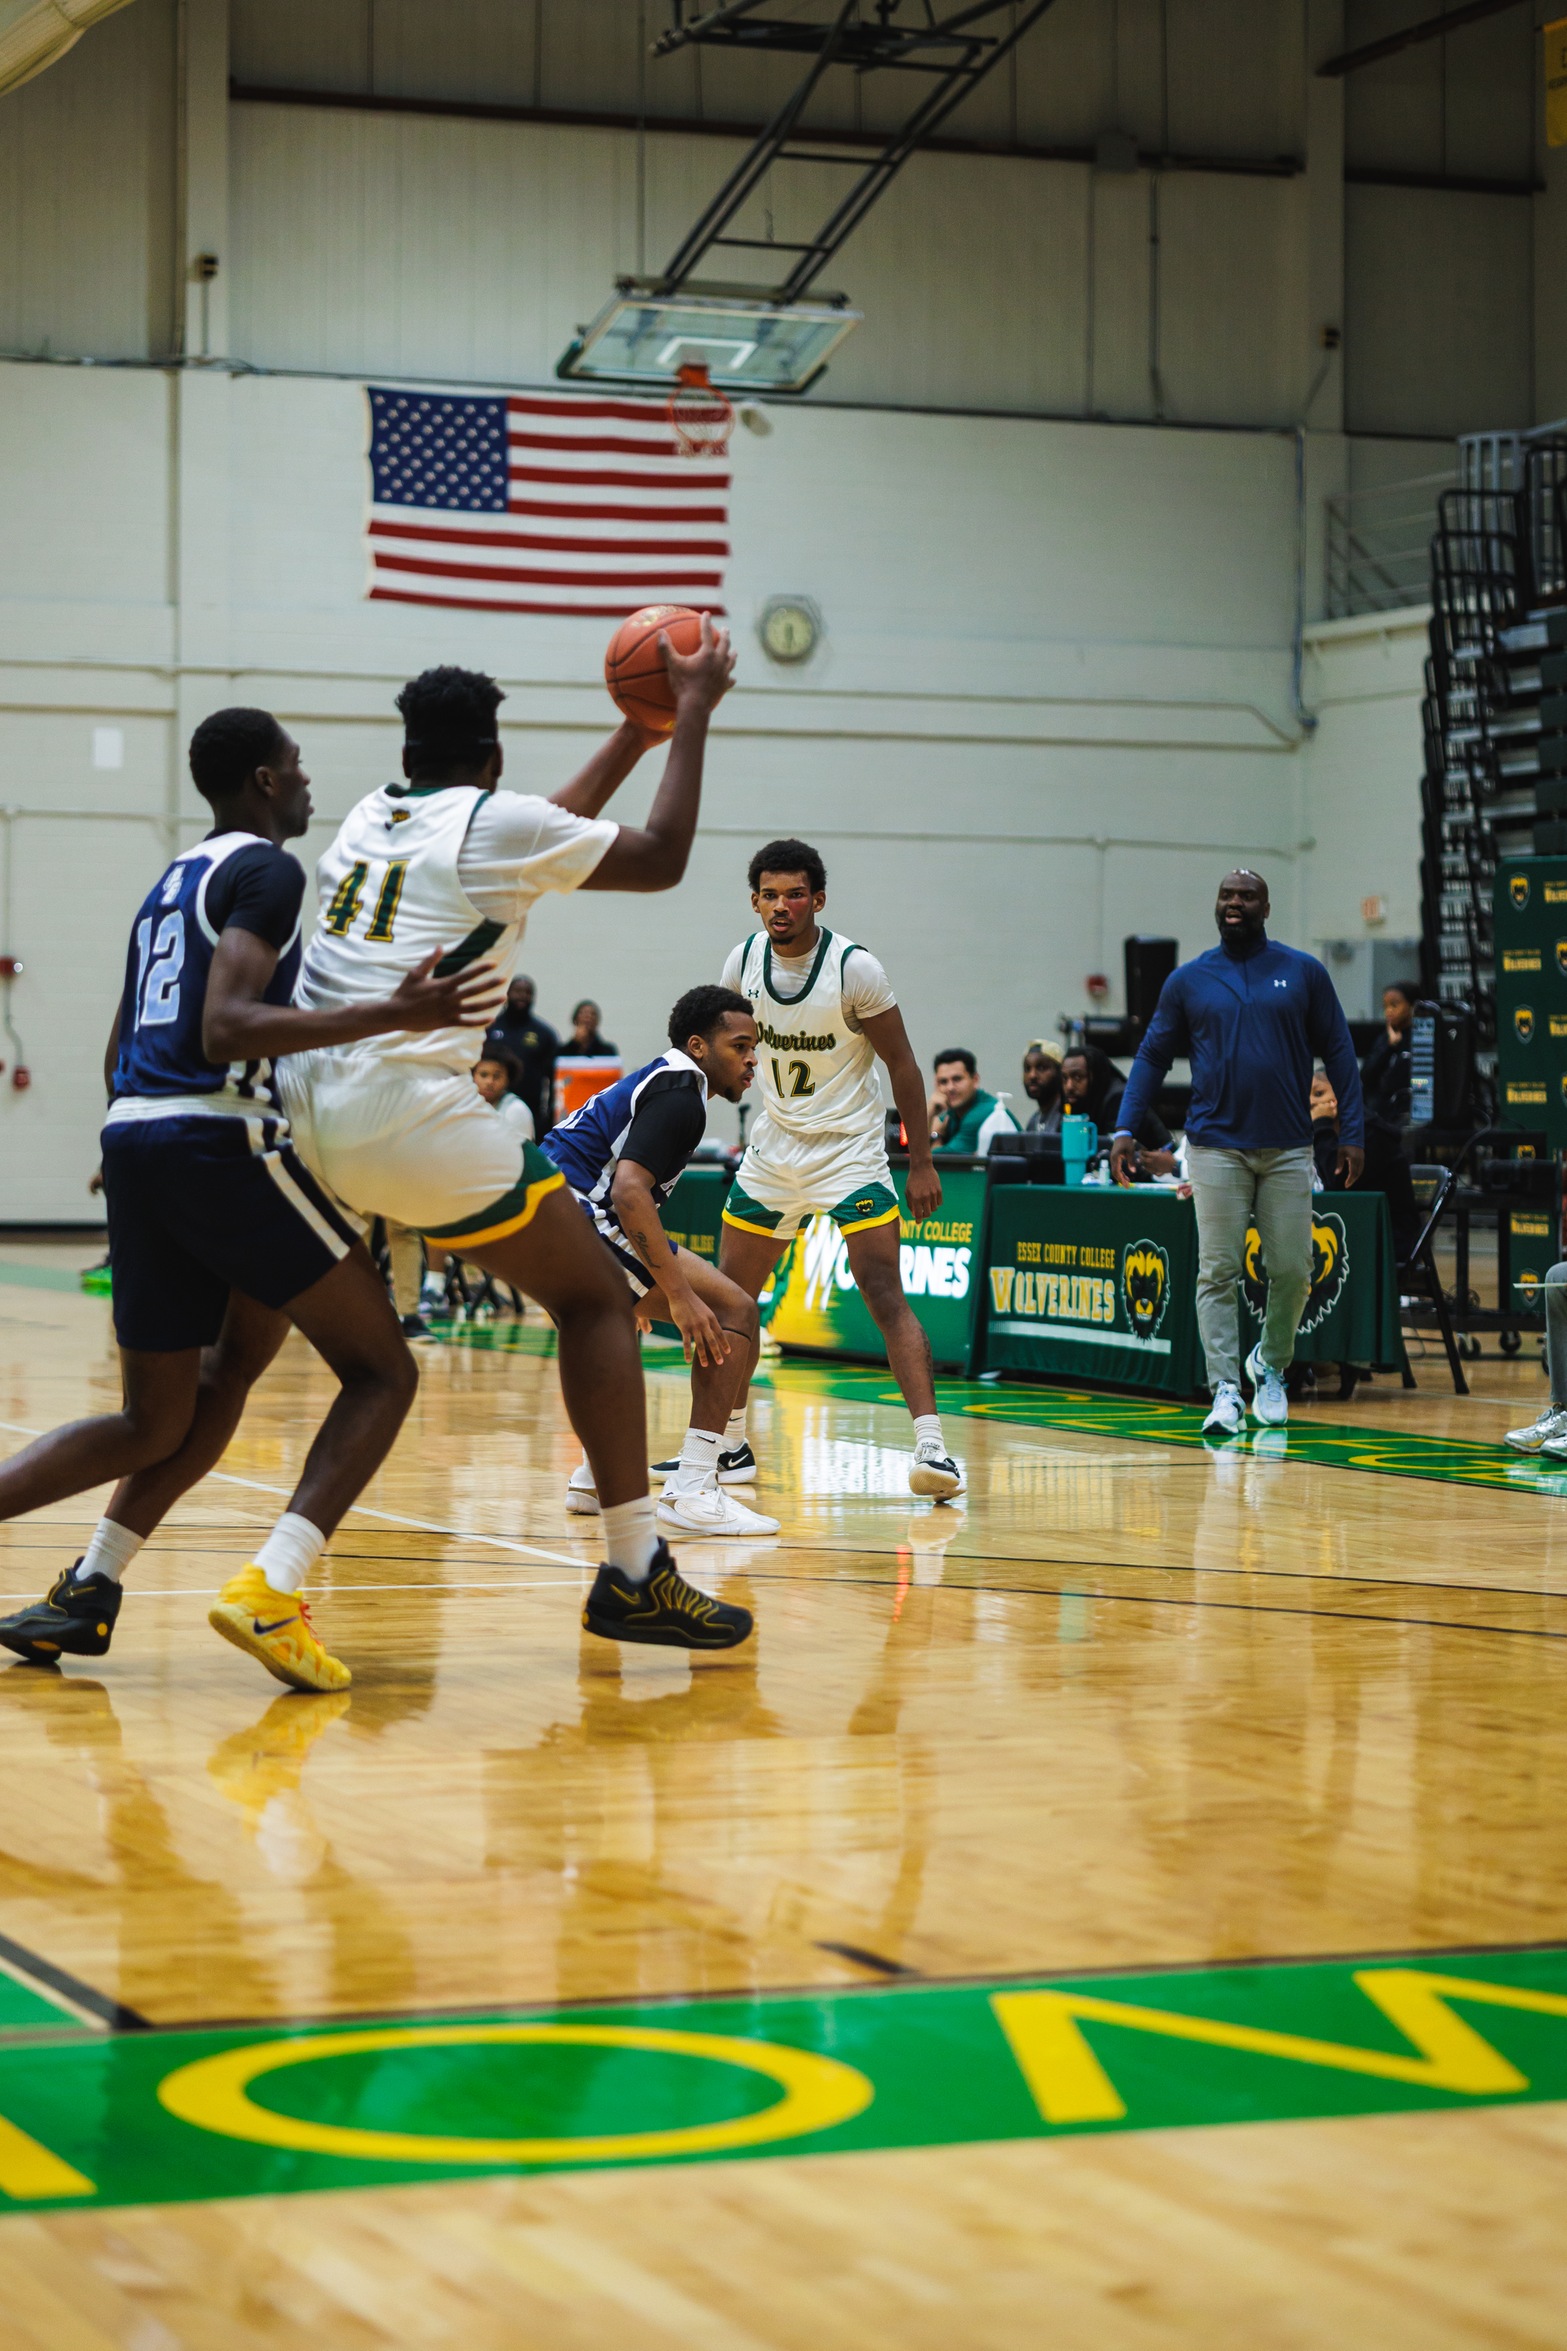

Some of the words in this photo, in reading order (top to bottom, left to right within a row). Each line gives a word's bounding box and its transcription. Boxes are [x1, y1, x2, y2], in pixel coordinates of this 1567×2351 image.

[325, 859, 410, 942] 41
[134, 909, 186, 1034] 12
[771, 1057, 816, 1098] 12
[924, 1220, 973, 1243] COLLEGE
[1017, 1241, 1042, 1262] ESSEX
[1043, 1243, 1078, 1265] COUNTY
[1080, 1246, 1116, 1269] COLLEGE
[989, 1266, 1115, 1323] WOLVERINES
